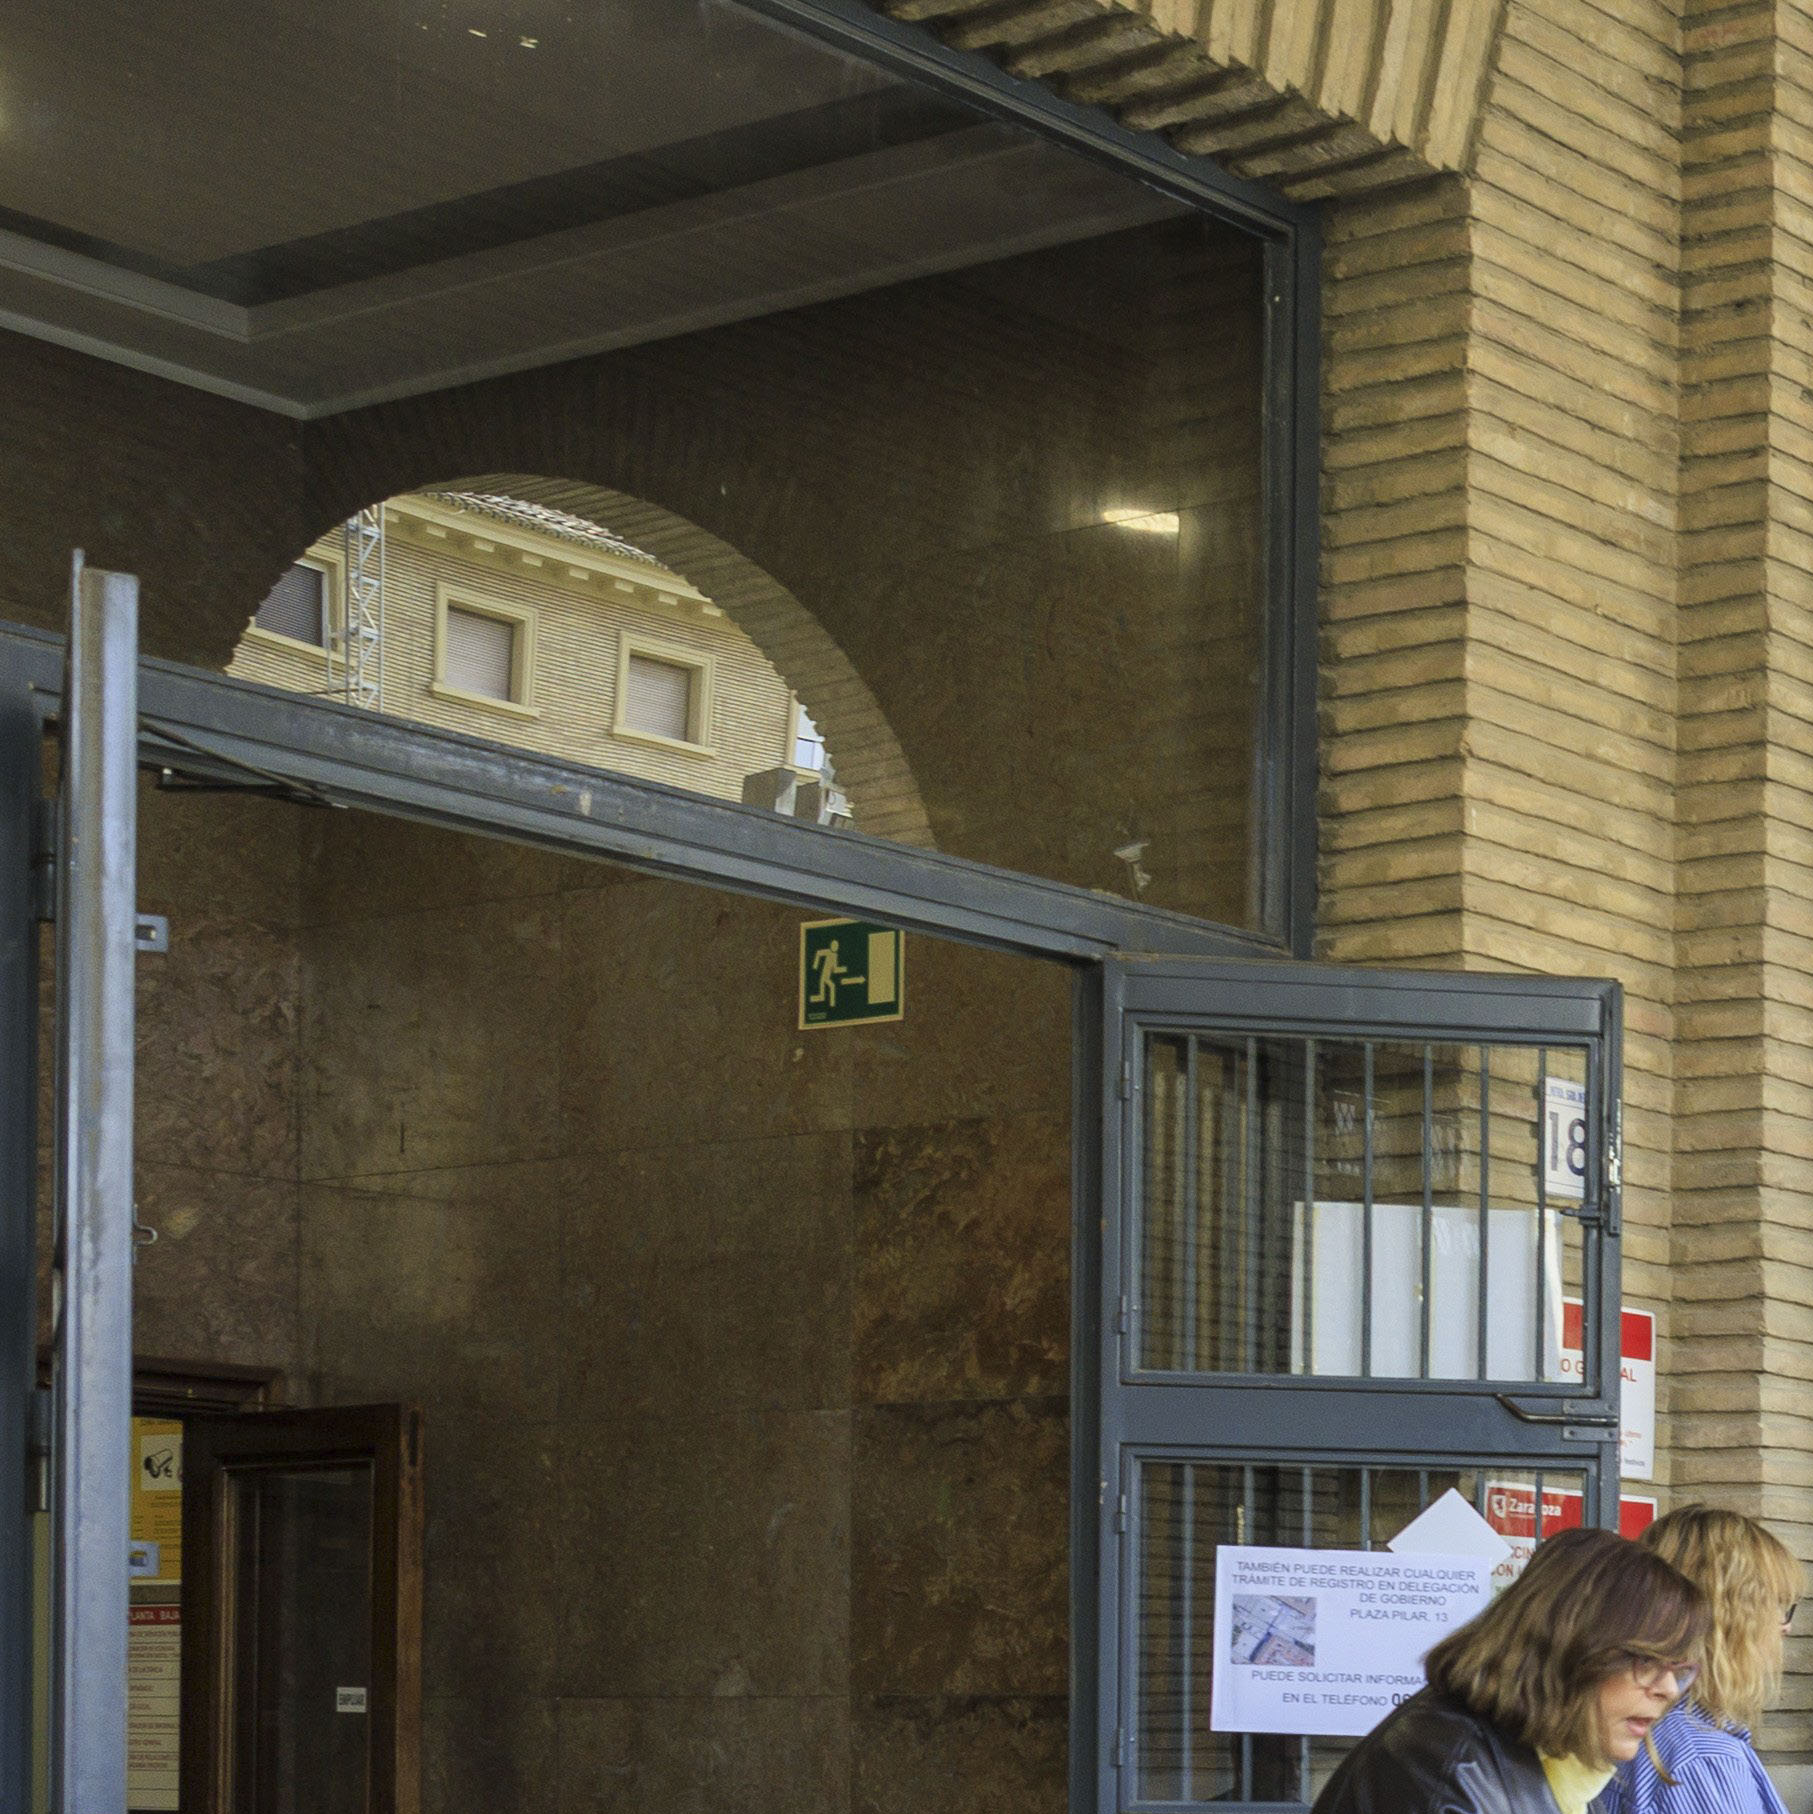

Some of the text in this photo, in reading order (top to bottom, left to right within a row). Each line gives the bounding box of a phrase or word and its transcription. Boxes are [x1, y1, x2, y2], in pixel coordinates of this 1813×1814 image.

[1548, 1111, 1585, 1176] 18
[1508, 1498, 1562, 1518] Zaraoza
[1294, 1563, 1337, 1575] PUEDE
[1341, 1565, 1400, 1577] REALIZAR
[1403, 1568, 1476, 1580] CUALQUIER
[1289, 1576, 1307, 1587] DE
[1310, 1577, 1375, 1590] REGISTRO
[1378, 1580, 1396, 1591] EN
[1360, 1592, 1447, 1606] DE GOBIERNO
[1350, 1608, 1389, 1620] PLAZA
[1435, 1612, 1449, 1622] 13
[1251, 1670, 1426, 1685] PUEDE SOLICITAR INFORMA
[1282, 1692, 1300, 1703] EN
[1303, 1693, 1317, 1704] EL
